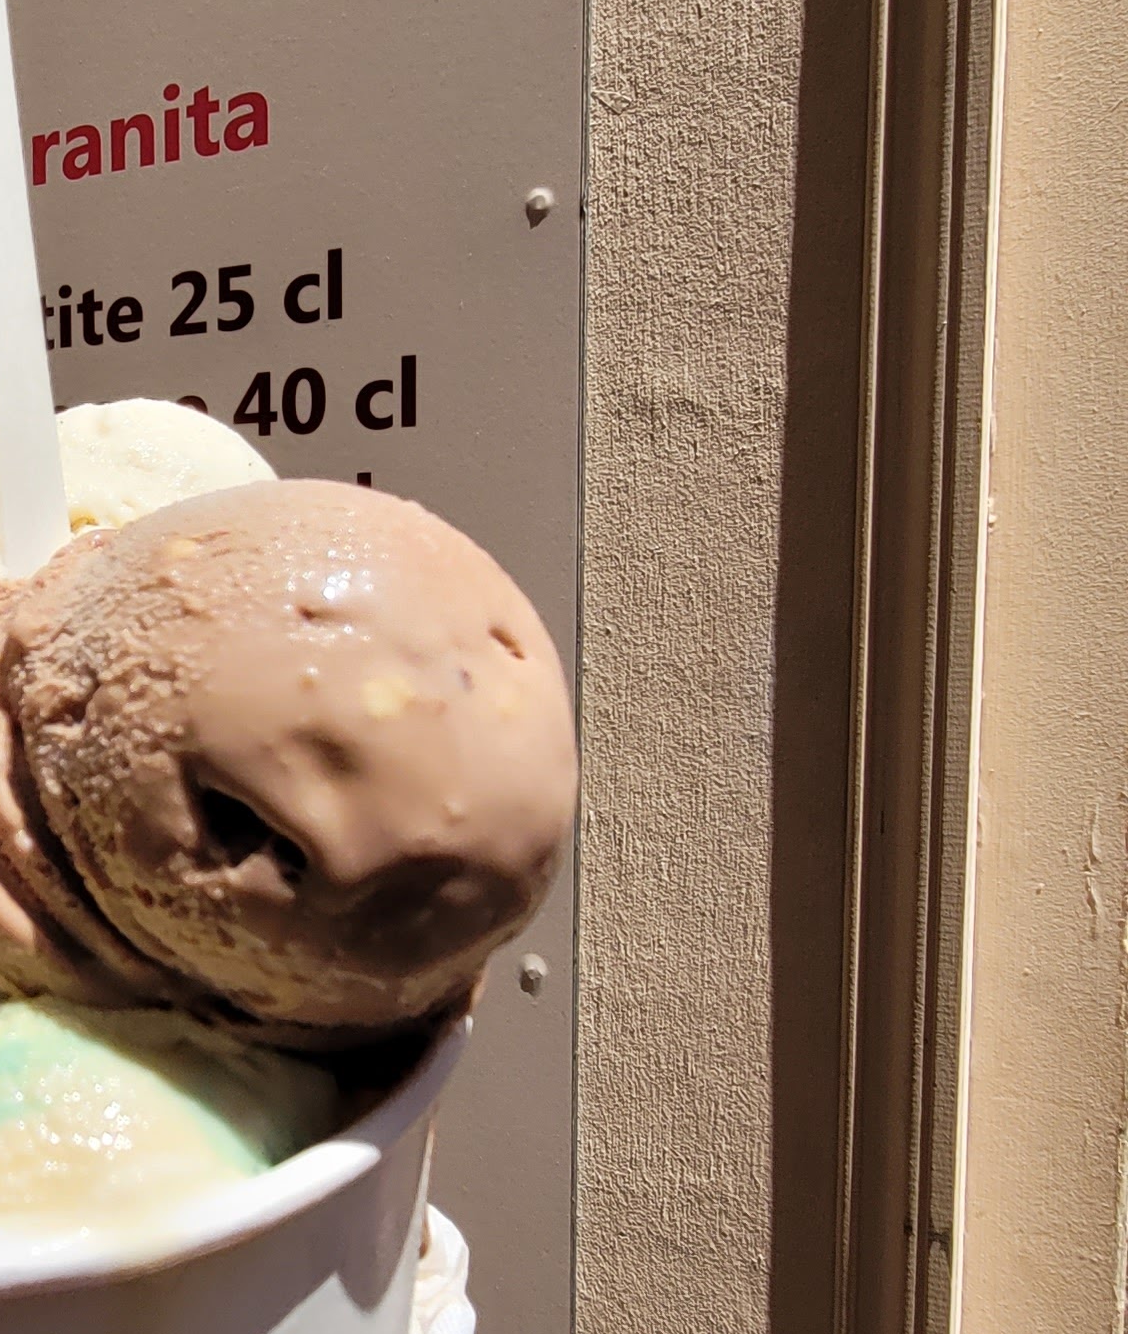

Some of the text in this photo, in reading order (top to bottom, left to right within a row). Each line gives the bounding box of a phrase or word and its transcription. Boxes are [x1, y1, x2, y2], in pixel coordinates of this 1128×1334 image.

[32, 83, 270, 186] ranita
[170, 264, 255, 337] 25
[284, 248, 343, 324] cl
[233, 367, 326, 437] 40
[355, 354, 417, 431] cl
